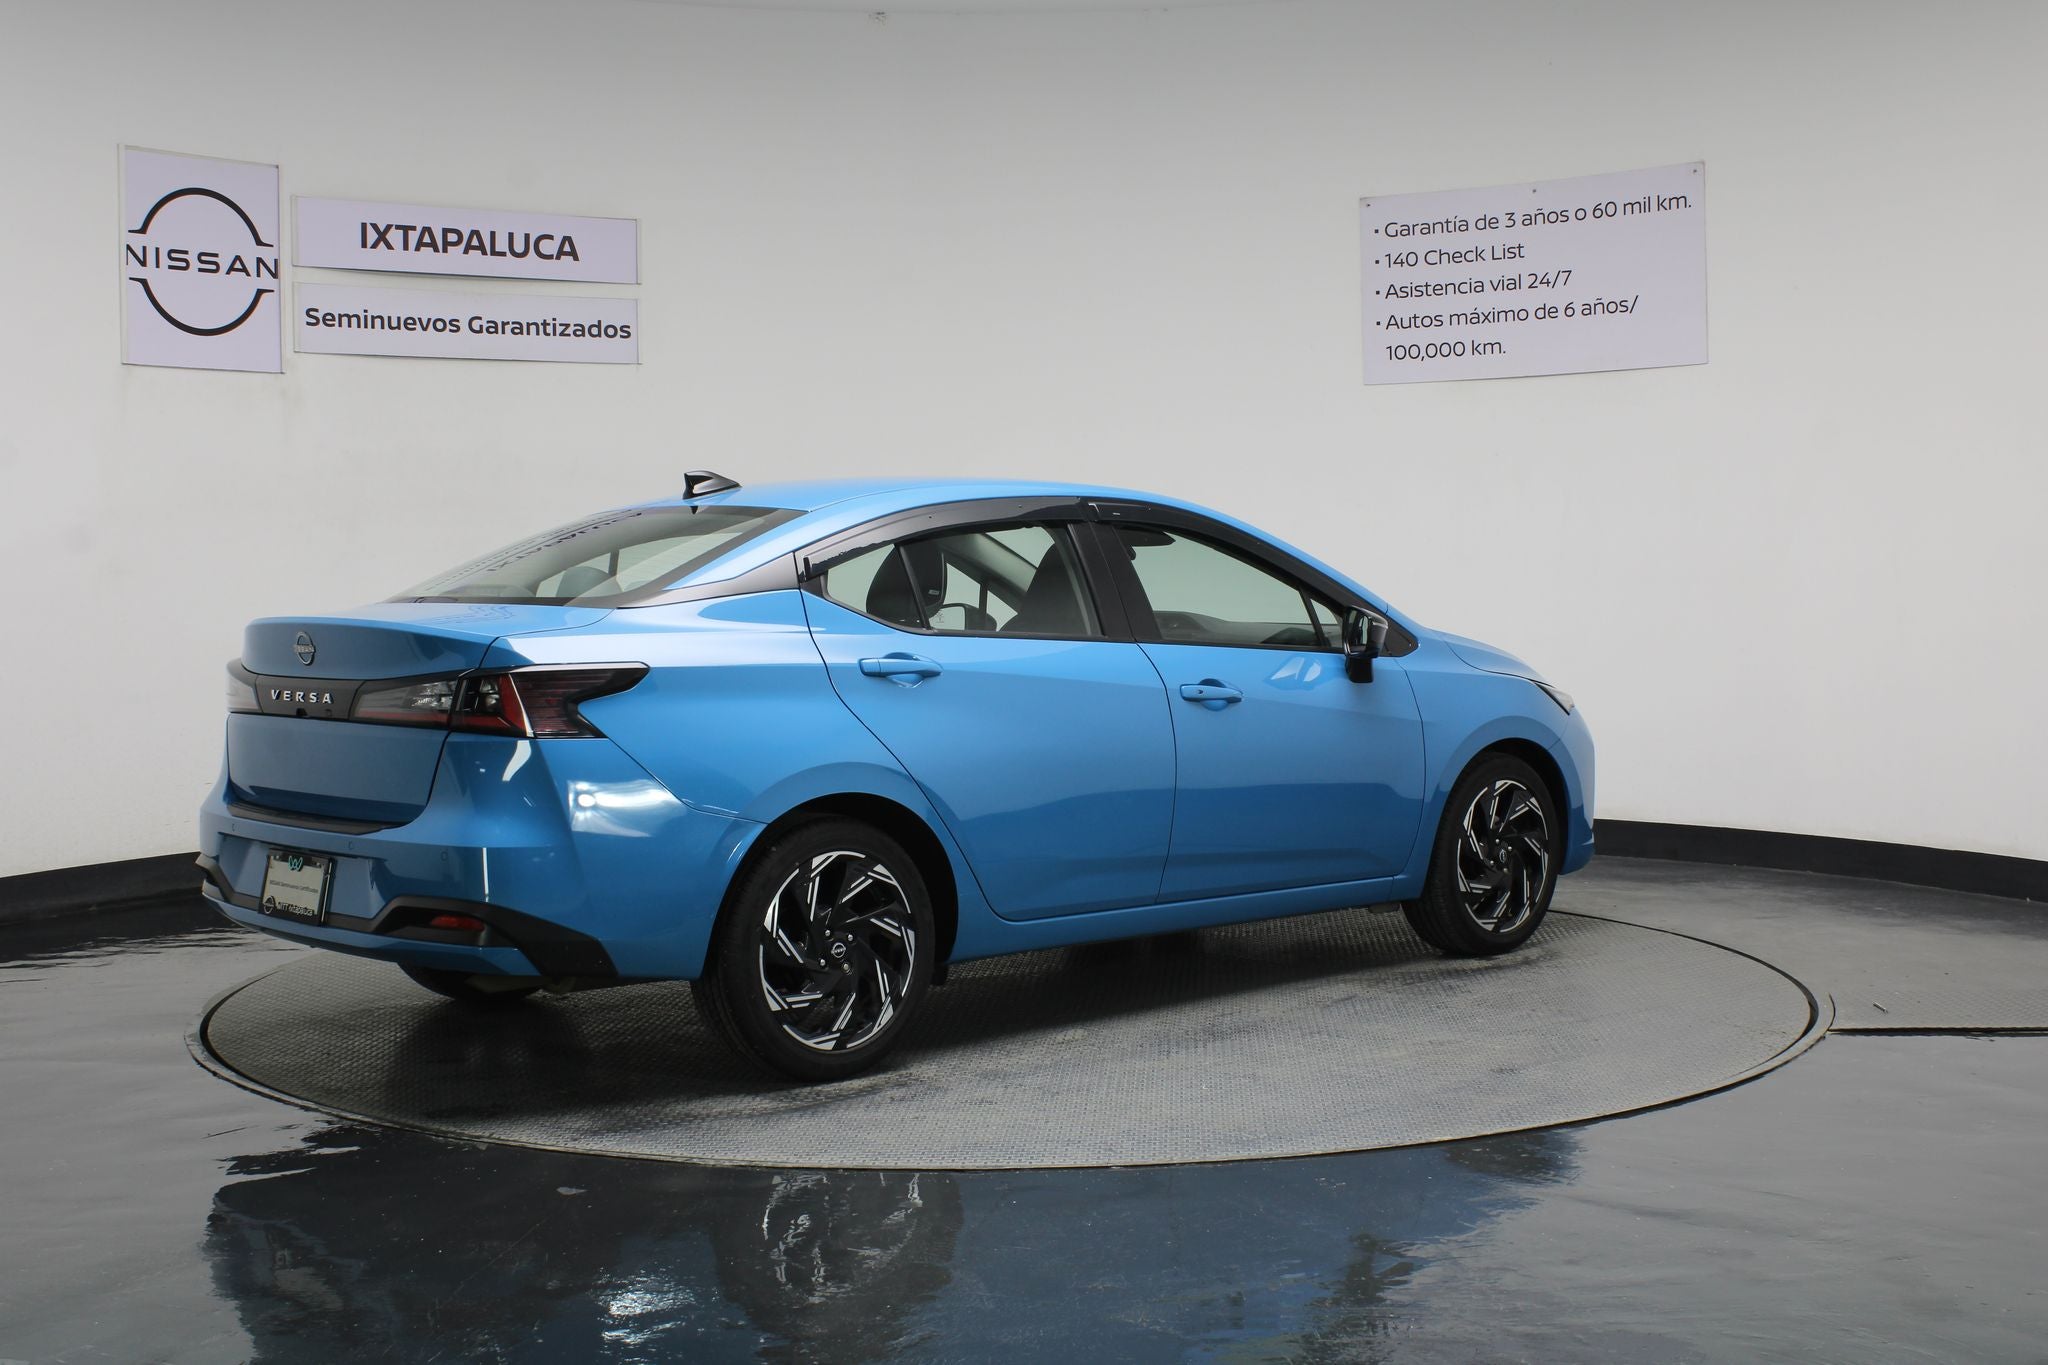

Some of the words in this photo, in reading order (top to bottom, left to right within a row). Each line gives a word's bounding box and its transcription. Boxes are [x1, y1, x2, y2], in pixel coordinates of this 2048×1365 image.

[1384, 215, 1469, 238] Garantía
[1474, 213, 1500, 231] de
[1504, 211, 1517, 229] 3
[1521, 207, 1570, 227] años
[1574, 207, 1587, 222] o
[1592, 200, 1618, 220] 60
[1623, 195, 1651, 217] mil
[1656, 194, 1692, 212] km.
[361, 221, 580, 262] IXTAPALUCA
[1384, 251, 1419, 269] 140
[1423, 245, 1486, 266] Check
[1491, 243, 1526, 261] List
[126, 243, 279, 280] NISSAN
[1384, 277, 1485, 300] Asistencia
[1489, 273, 1522, 292] vial
[1527, 269, 1573, 290] 24/7
[305, 307, 461, 334] Seminuevos
[467, 315, 632, 339] Garantizados
[1385, 312, 1444, 331] Autos
[1449, 306, 1529, 327] máximo
[1534, 302, 1559, 321] de
[1563, 301, 1576, 318] 6
[1580, 294, 1640, 317] años/
[1385, 341, 1466, 362] 100,000
[1471, 339, 1506, 356] km.
[271, 689, 332, 704] VERSA
